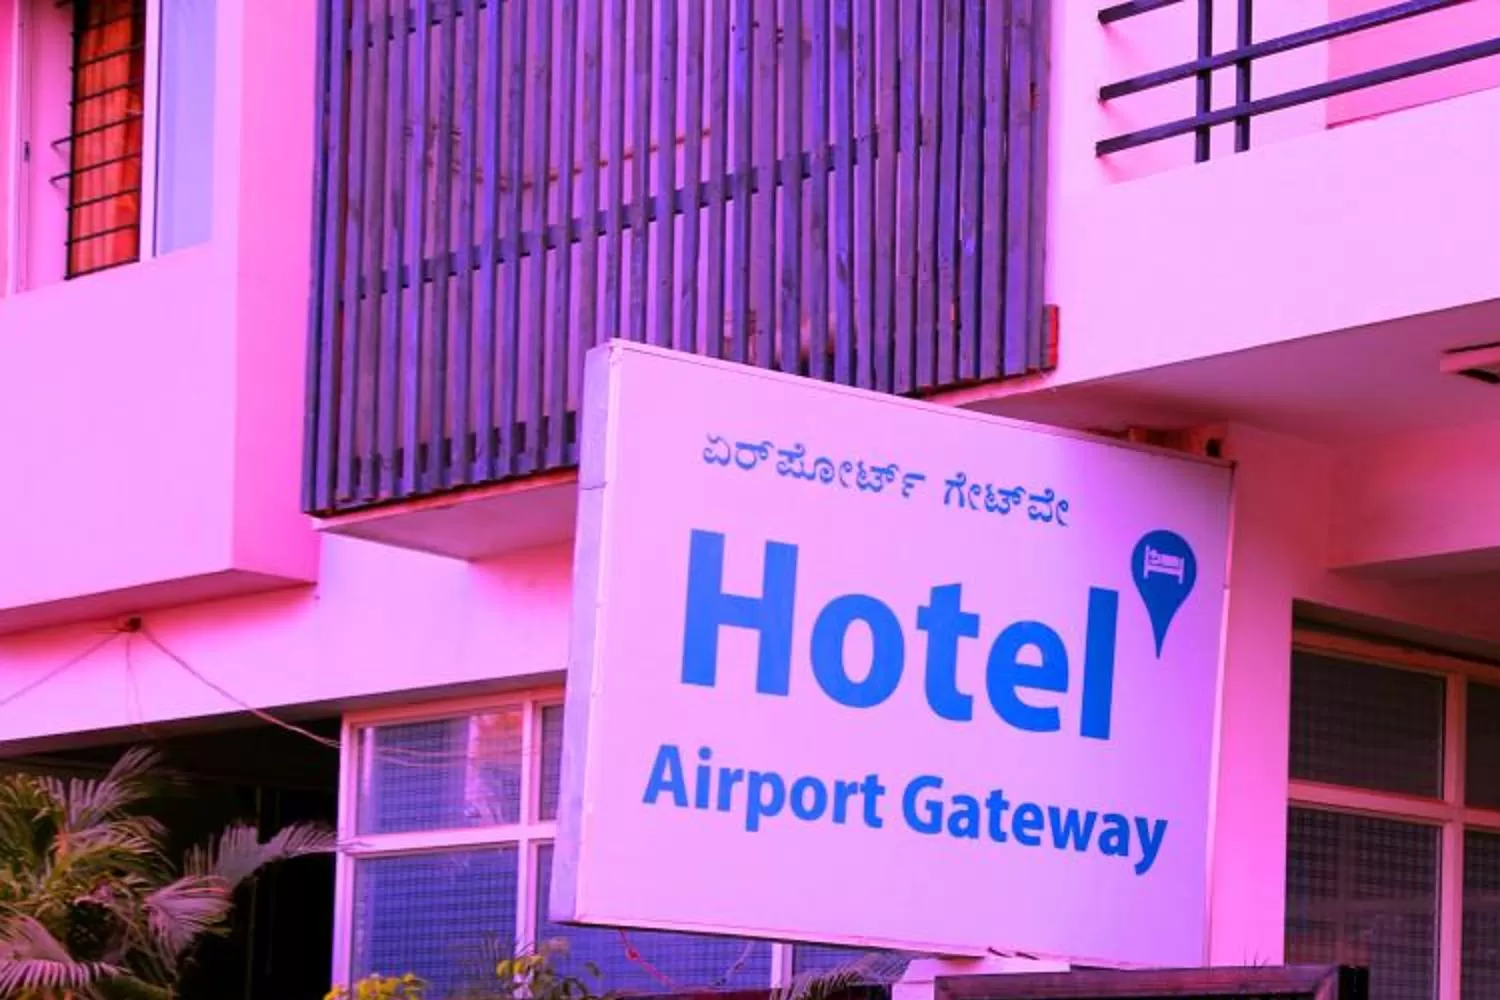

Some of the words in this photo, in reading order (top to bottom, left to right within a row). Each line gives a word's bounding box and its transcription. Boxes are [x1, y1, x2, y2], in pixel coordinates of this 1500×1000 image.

[681, 529, 1119, 741] Hotel
[642, 745, 886, 833] Airport
[902, 774, 1168, 876] Gateway
